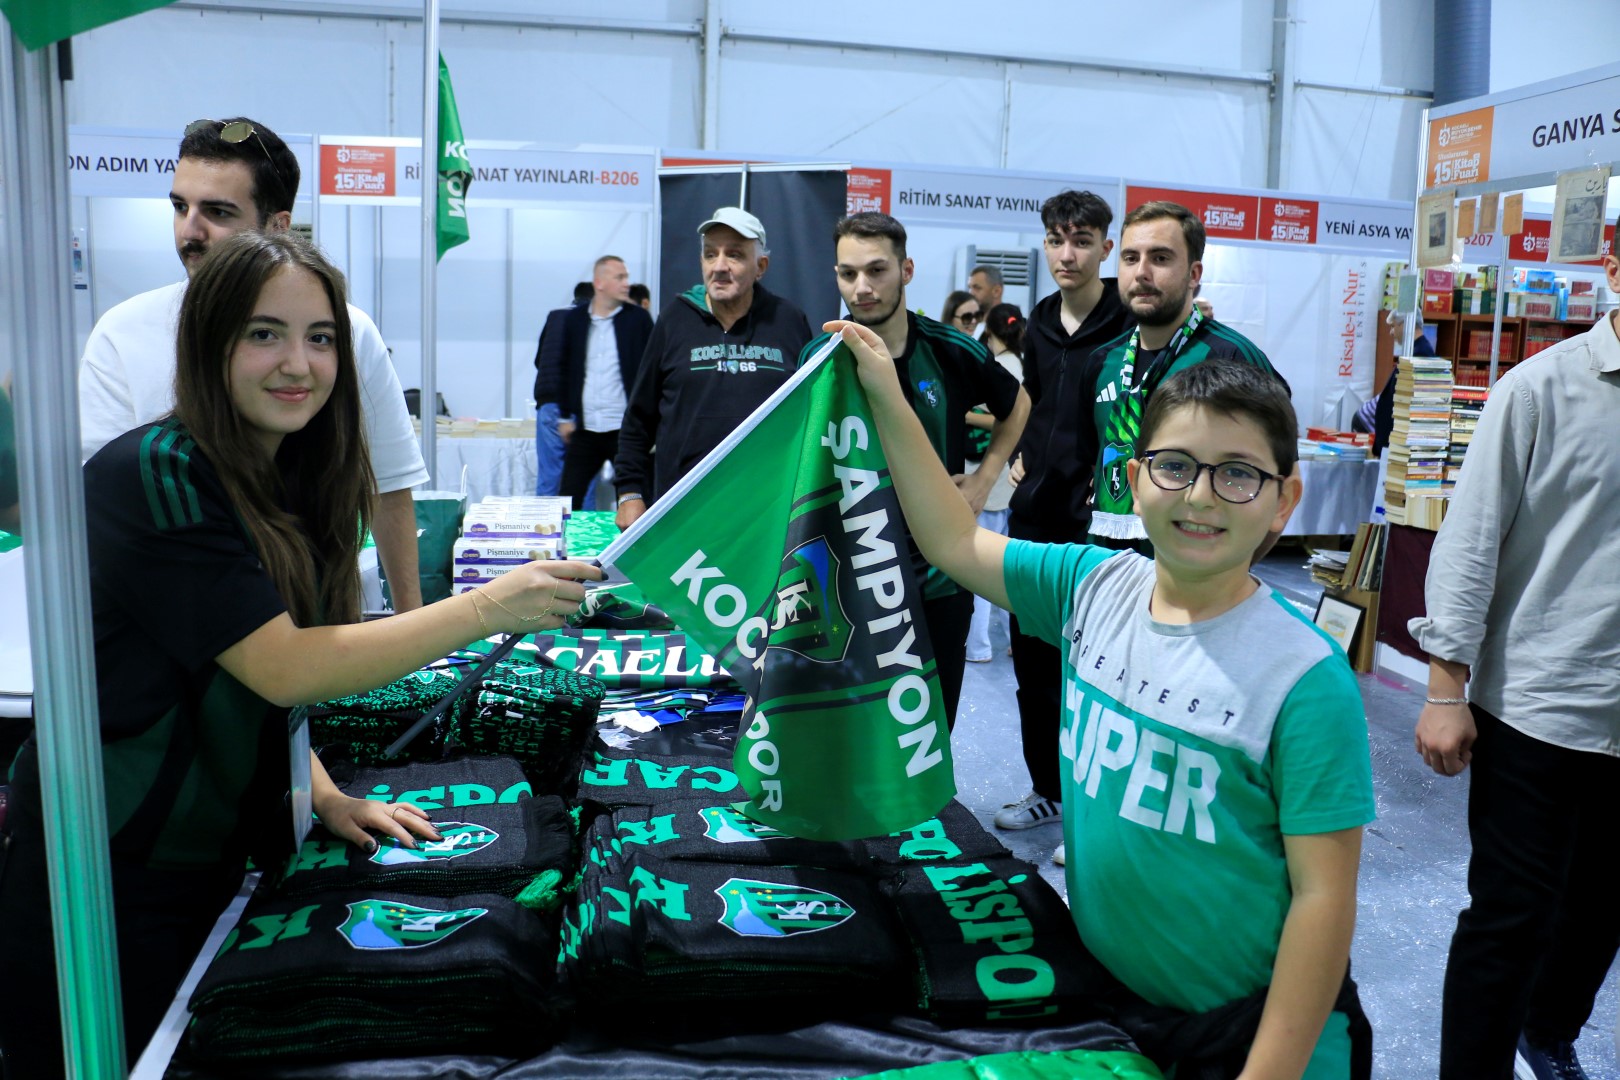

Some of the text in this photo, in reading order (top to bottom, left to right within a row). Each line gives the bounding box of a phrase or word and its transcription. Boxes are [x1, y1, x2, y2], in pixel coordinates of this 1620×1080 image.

[1532, 113, 1604, 148] GANYA
[96, 156, 148, 173] ADIM
[154, 158, 180, 173] YA
[1433, 160, 1451, 184] 15
[1454, 153, 1480, 169] Kitap
[334, 173, 355, 189] 15
[899, 189, 1044, 213] RİTİM SANAT YAYINL
[1204, 210, 1220, 225] 15
[1271, 225, 1286, 239] 15
[1325, 219, 1413, 240] YENİ ASYA YA
[1338, 269, 1358, 377] Risale-i Nur
[487, 549, 525, 557] Pişmaniye
[821, 415, 943, 778] ŞAMPİYON
